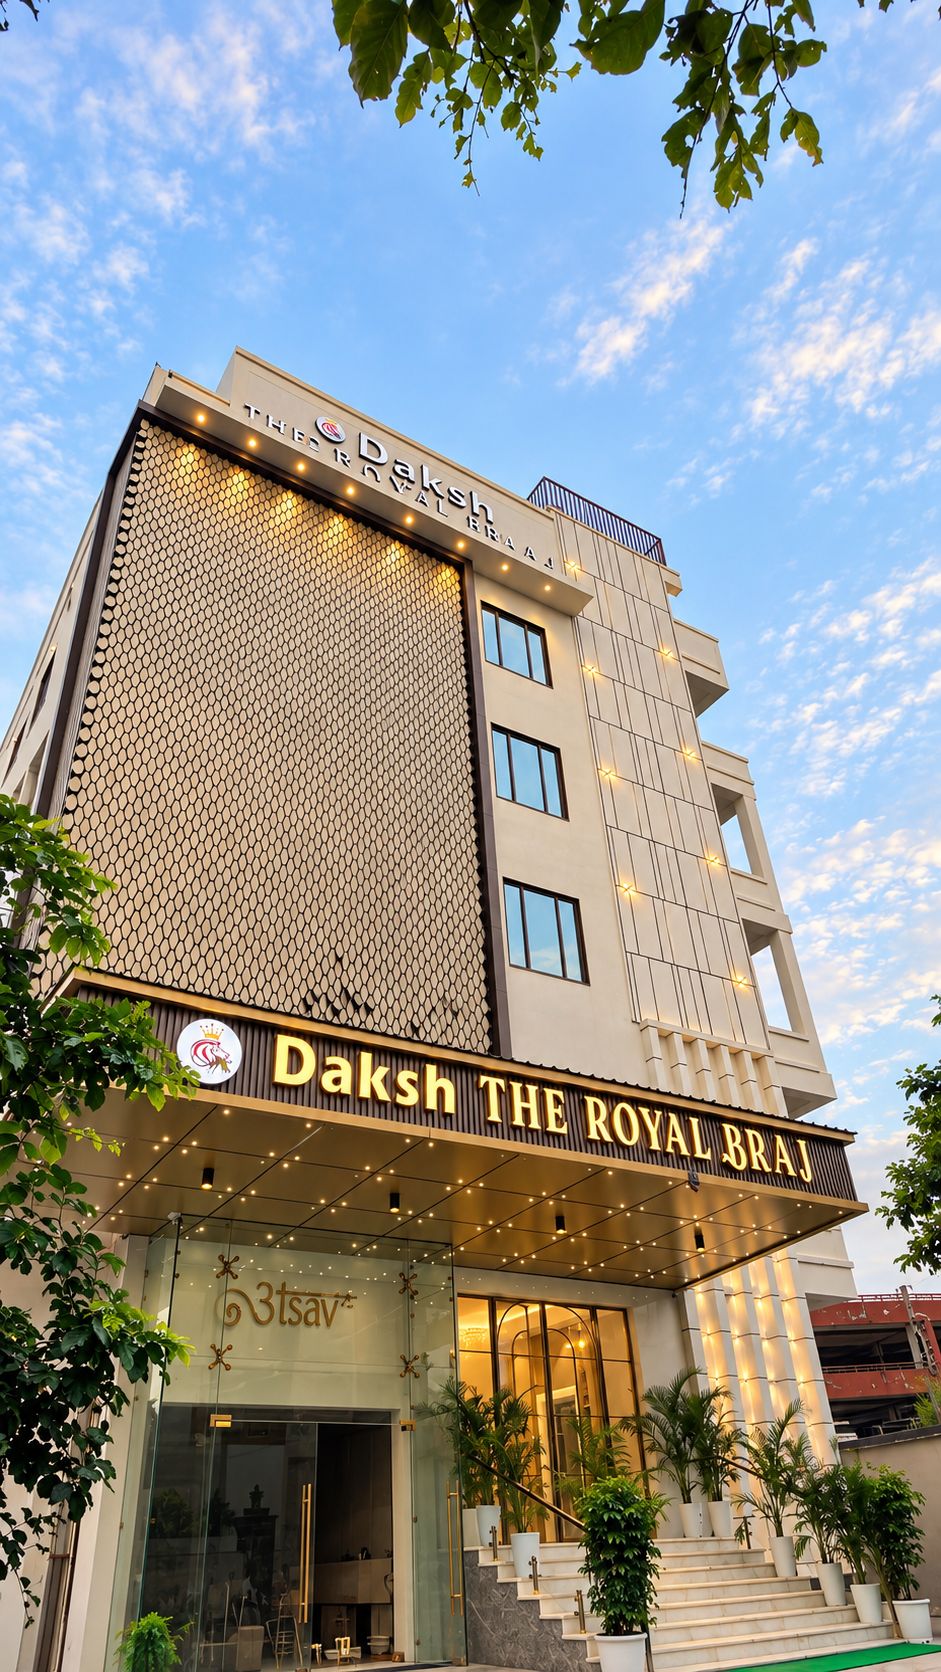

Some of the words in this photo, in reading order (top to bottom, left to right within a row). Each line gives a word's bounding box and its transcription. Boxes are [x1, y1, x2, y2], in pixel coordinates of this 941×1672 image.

[359, 432, 494, 525] Daksh
[272, 1033, 456, 1115] Daksh
[477, 1074, 568, 1136] THE
[582, 1094, 712, 1161] ROYAL
[720, 1122, 813, 1183] BRAJ
